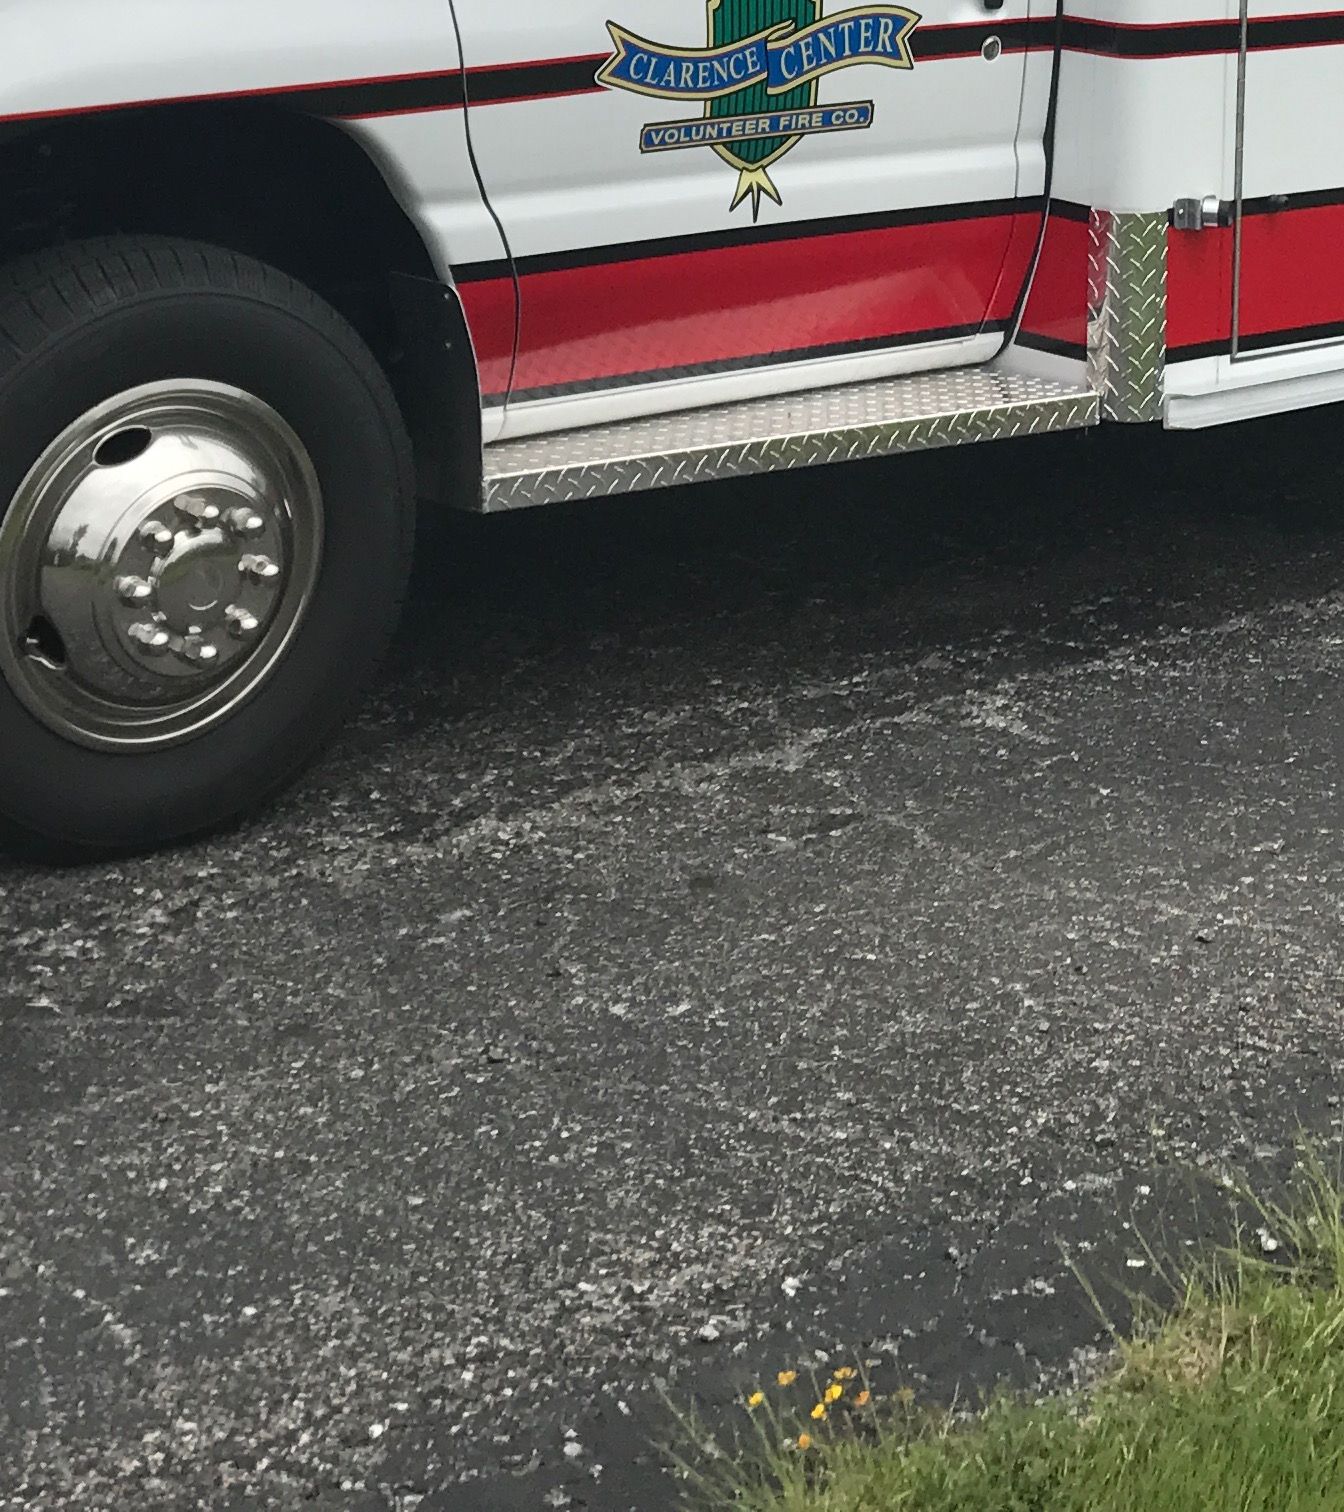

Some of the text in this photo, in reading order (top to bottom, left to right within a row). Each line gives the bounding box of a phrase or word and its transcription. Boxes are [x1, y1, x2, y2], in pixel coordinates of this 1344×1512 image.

[629, 17, 894, 88] CLARENCE CENTER
[650, 108, 864, 145] VOLUNTEER FIRE CO.
